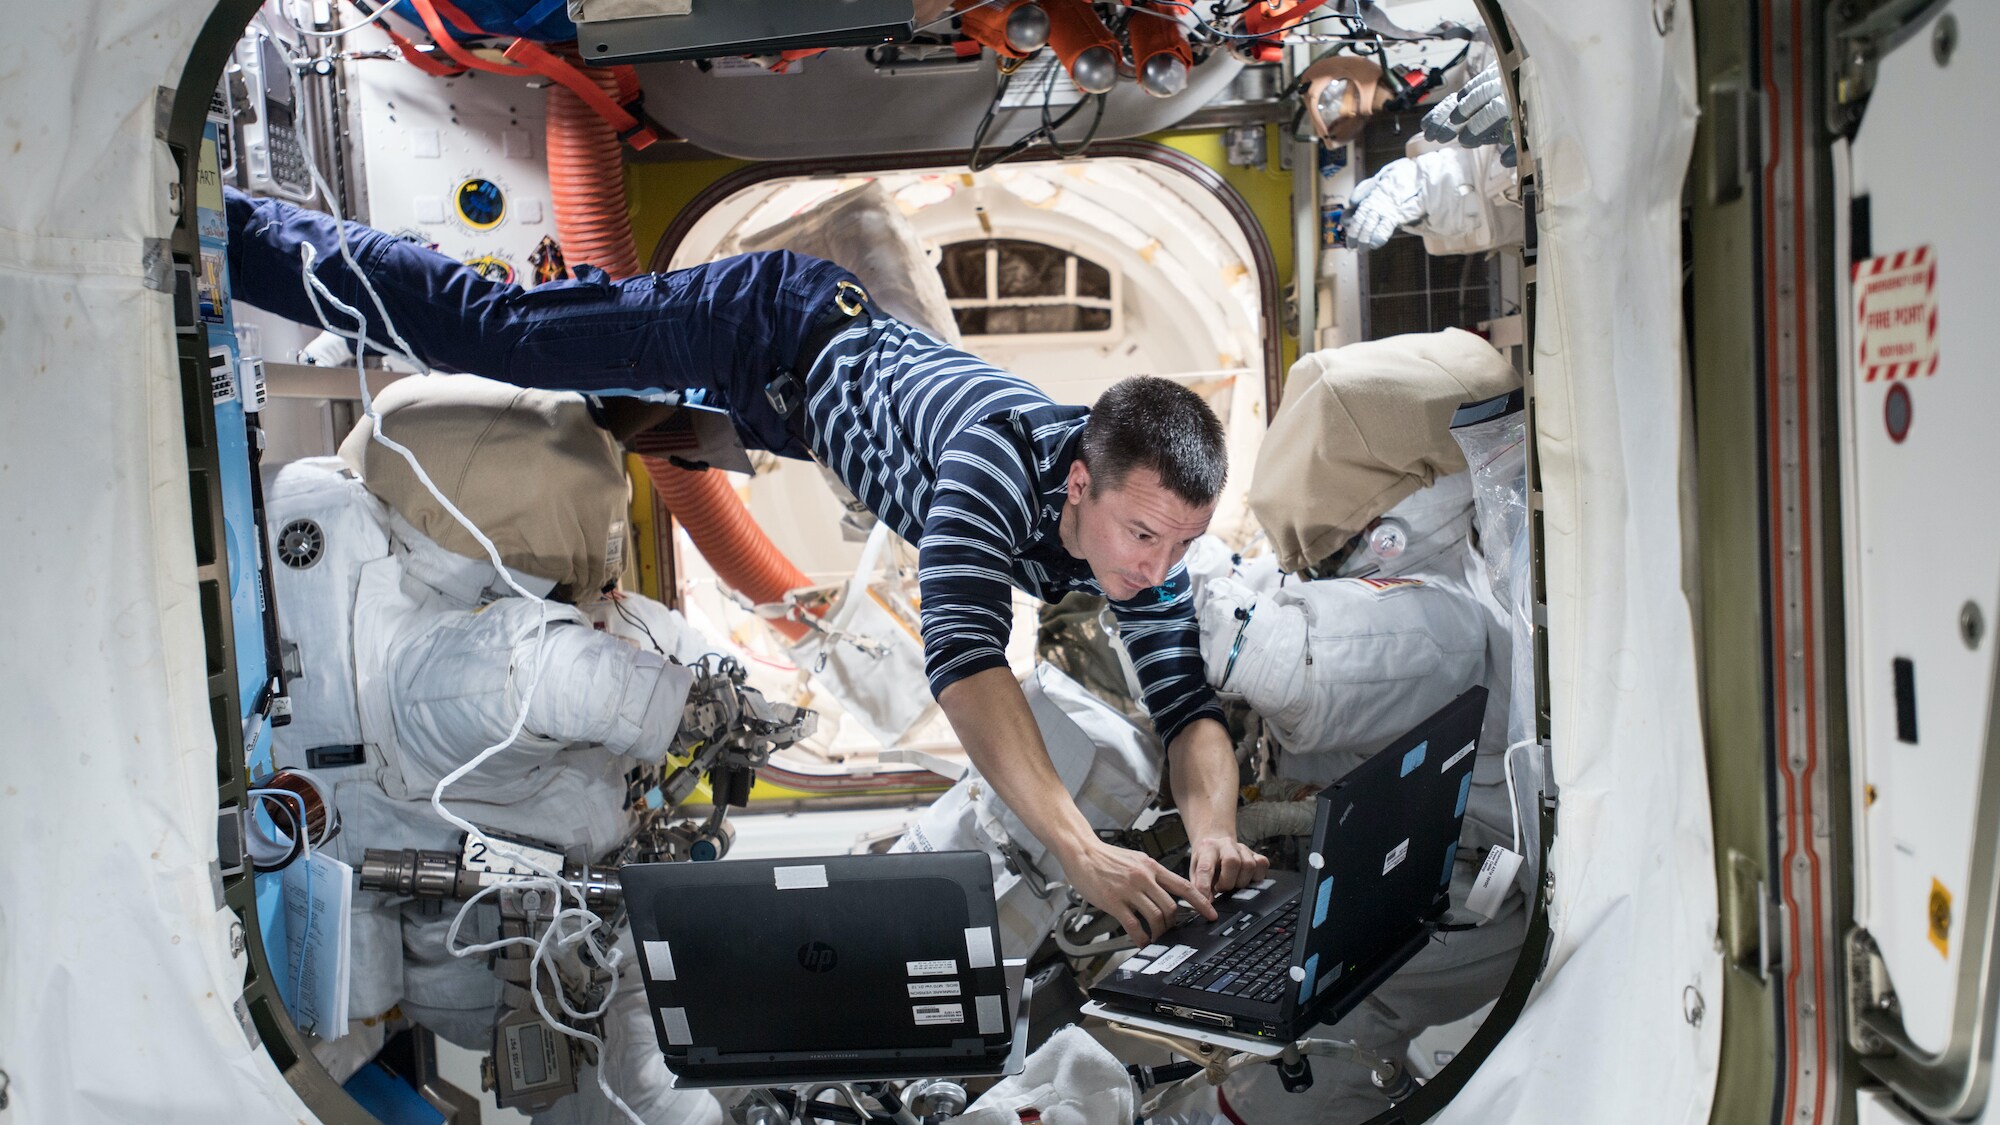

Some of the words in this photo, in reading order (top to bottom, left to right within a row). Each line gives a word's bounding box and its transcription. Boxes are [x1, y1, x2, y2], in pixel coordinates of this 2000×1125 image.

[1867, 310, 1890, 329] FIRE
[1894, 303, 1924, 325] PORT
[469, 842, 488, 863] 2
[803, 941, 834, 971] hp
